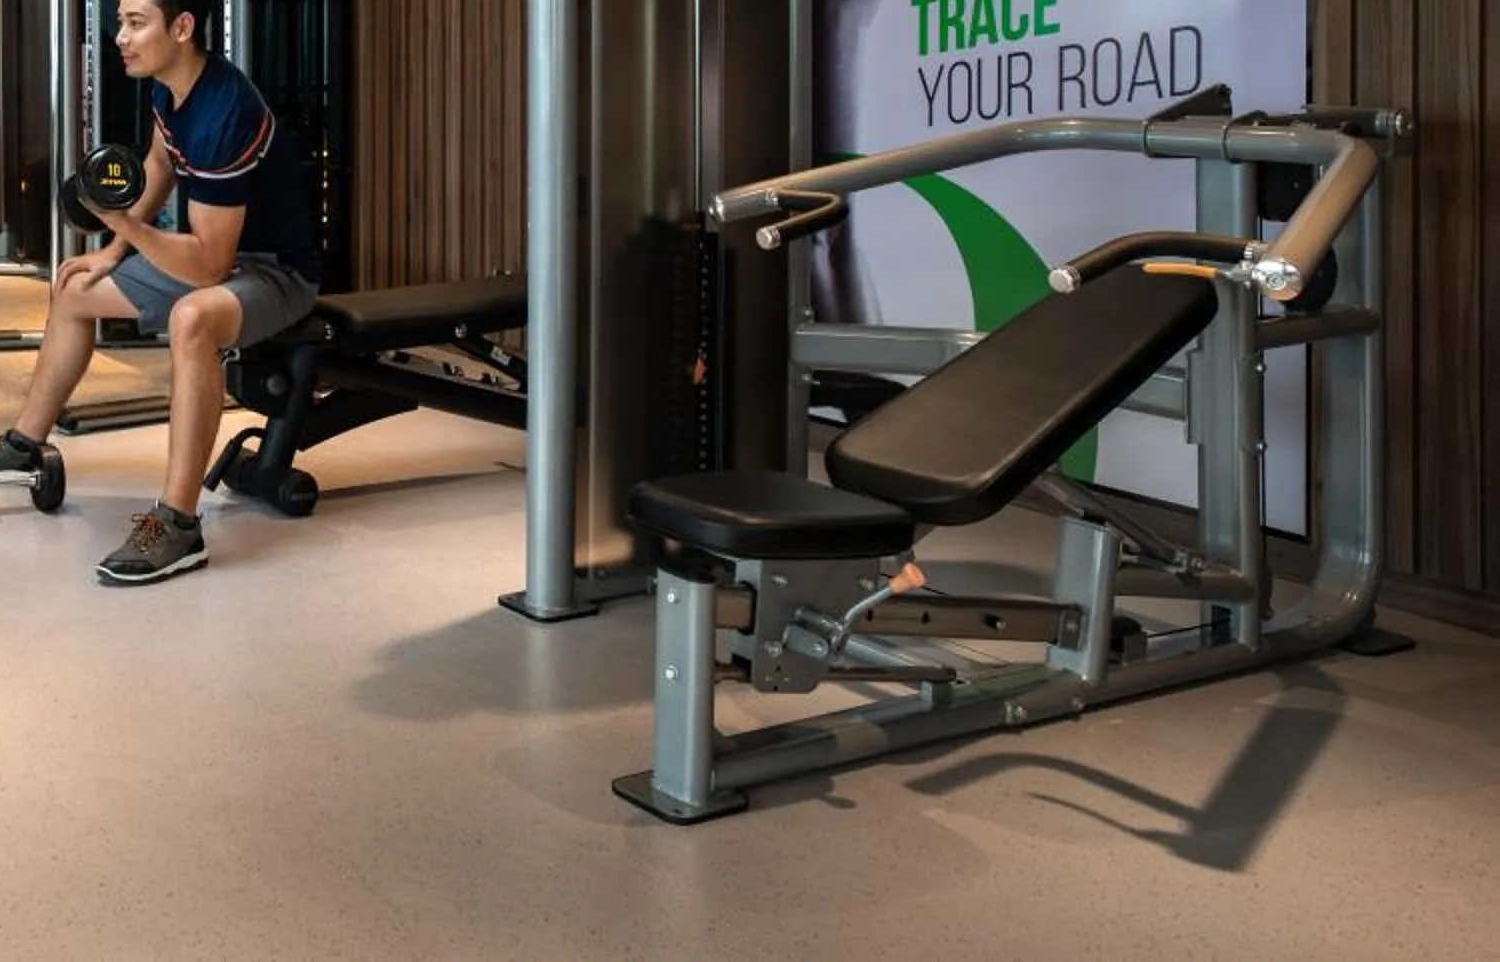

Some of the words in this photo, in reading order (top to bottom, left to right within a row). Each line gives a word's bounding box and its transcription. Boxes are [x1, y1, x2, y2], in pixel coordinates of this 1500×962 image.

[917, 51, 1034, 127] YOUR
[1057, 25, 1203, 111] ROAD
[107, 162, 121, 177] 10
